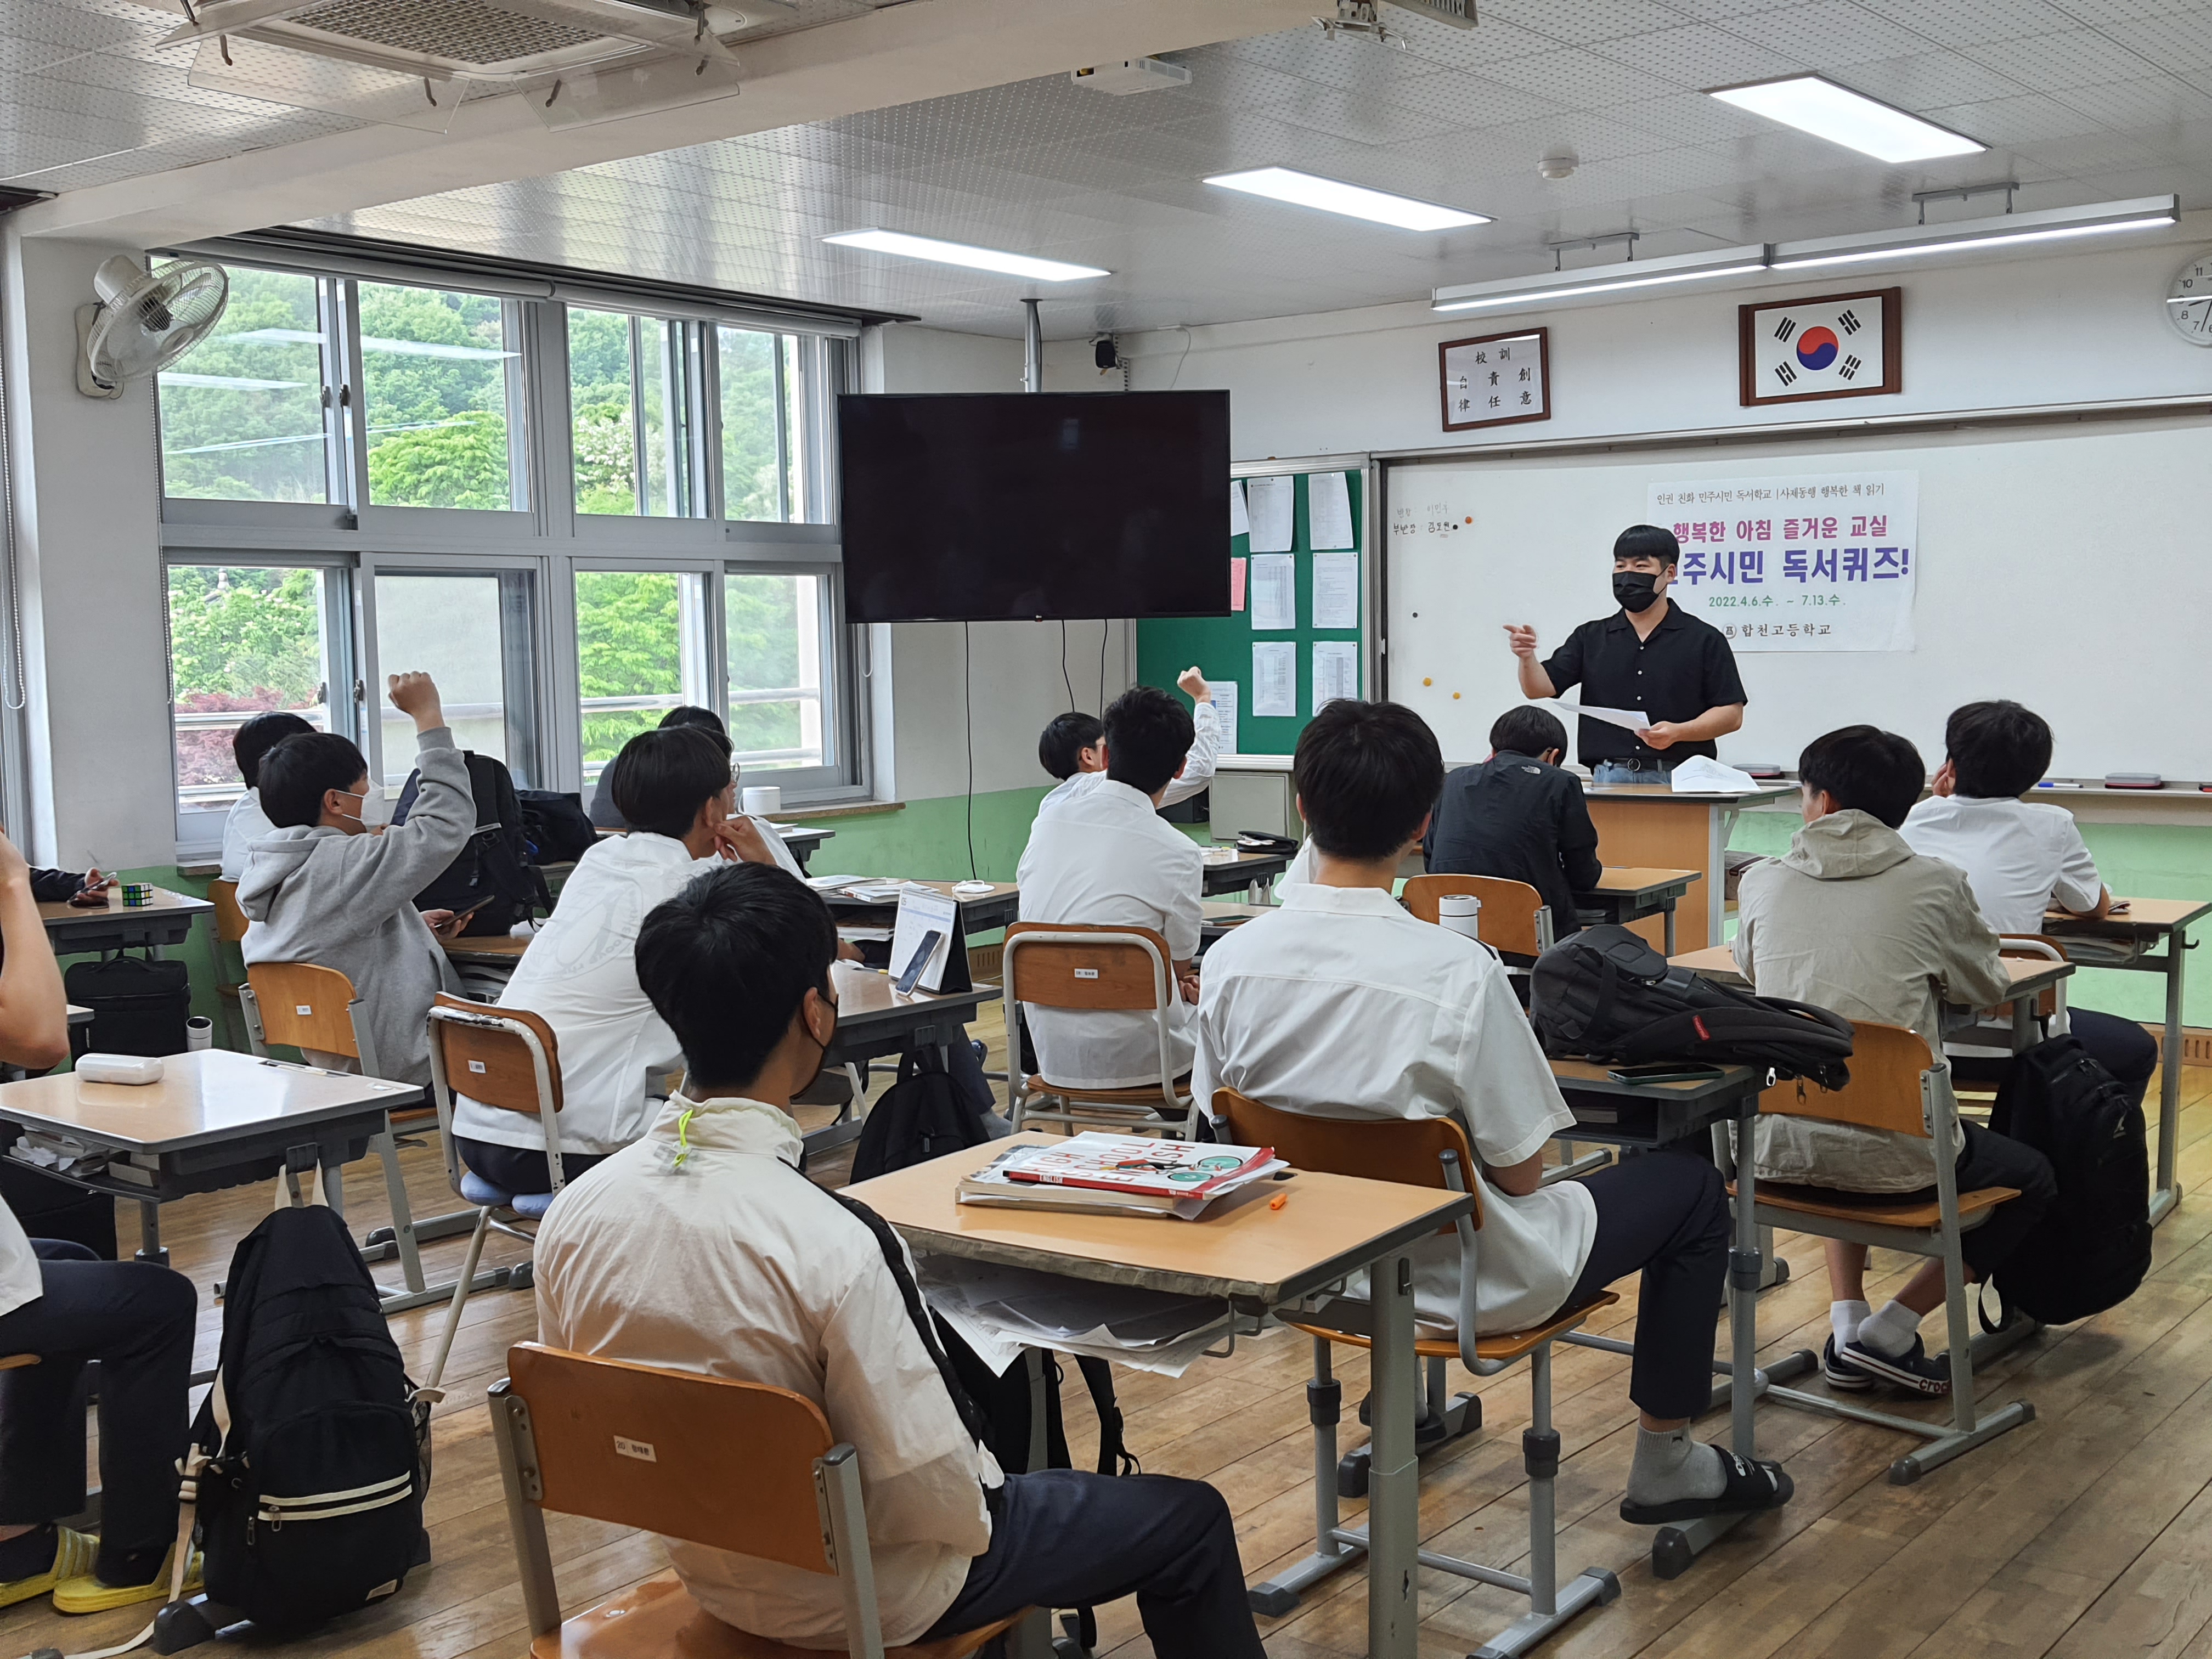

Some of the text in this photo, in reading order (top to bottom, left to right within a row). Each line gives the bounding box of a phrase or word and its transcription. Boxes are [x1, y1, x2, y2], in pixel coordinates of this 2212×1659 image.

[2195, 267, 2203, 276] 11
[2182, 279, 2193, 289] 10
[2181, 310, 2188, 319] 8
[2193, 321, 2199, 330] 7
[1475, 347, 1510, 364] 校訓
[1657, 483, 1884, 505] 인권 친화 민주시민 독서학교 사제동행 행복한 책 읽기
[1673, 515, 1887, 544] 행복한 아침 즐거운 교실
[1669, 547, 1909, 585] 주시민 독서퀴즈!
[1741, 623, 1831, 637] 합천고등학교
[1019, 1152, 1085, 1172] HIGH
[1061, 1142, 1155, 1177] SCHOOL
